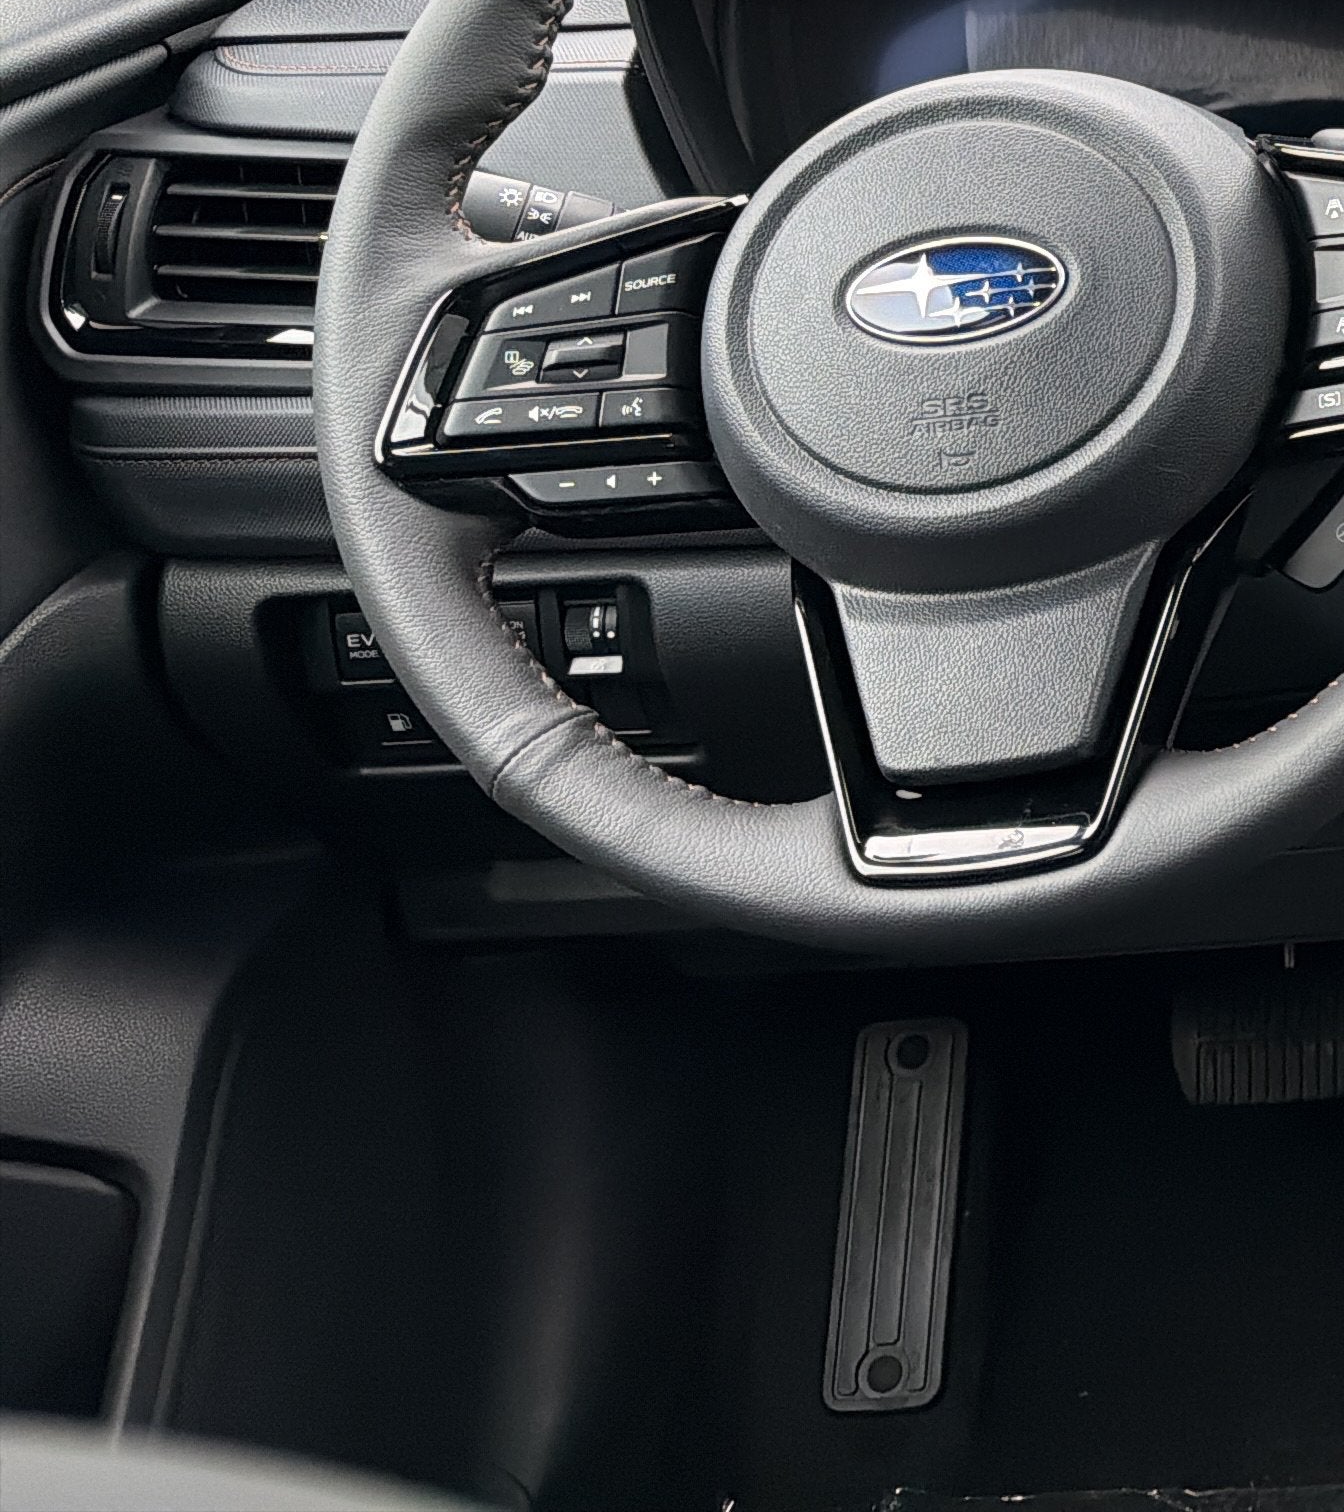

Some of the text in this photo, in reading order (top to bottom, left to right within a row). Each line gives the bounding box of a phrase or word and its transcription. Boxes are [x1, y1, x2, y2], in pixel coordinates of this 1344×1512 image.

[624, 273, 677, 292] SOURCE
[347, 633, 376, 648] EV
[349, 649, 380, 659] MODE
